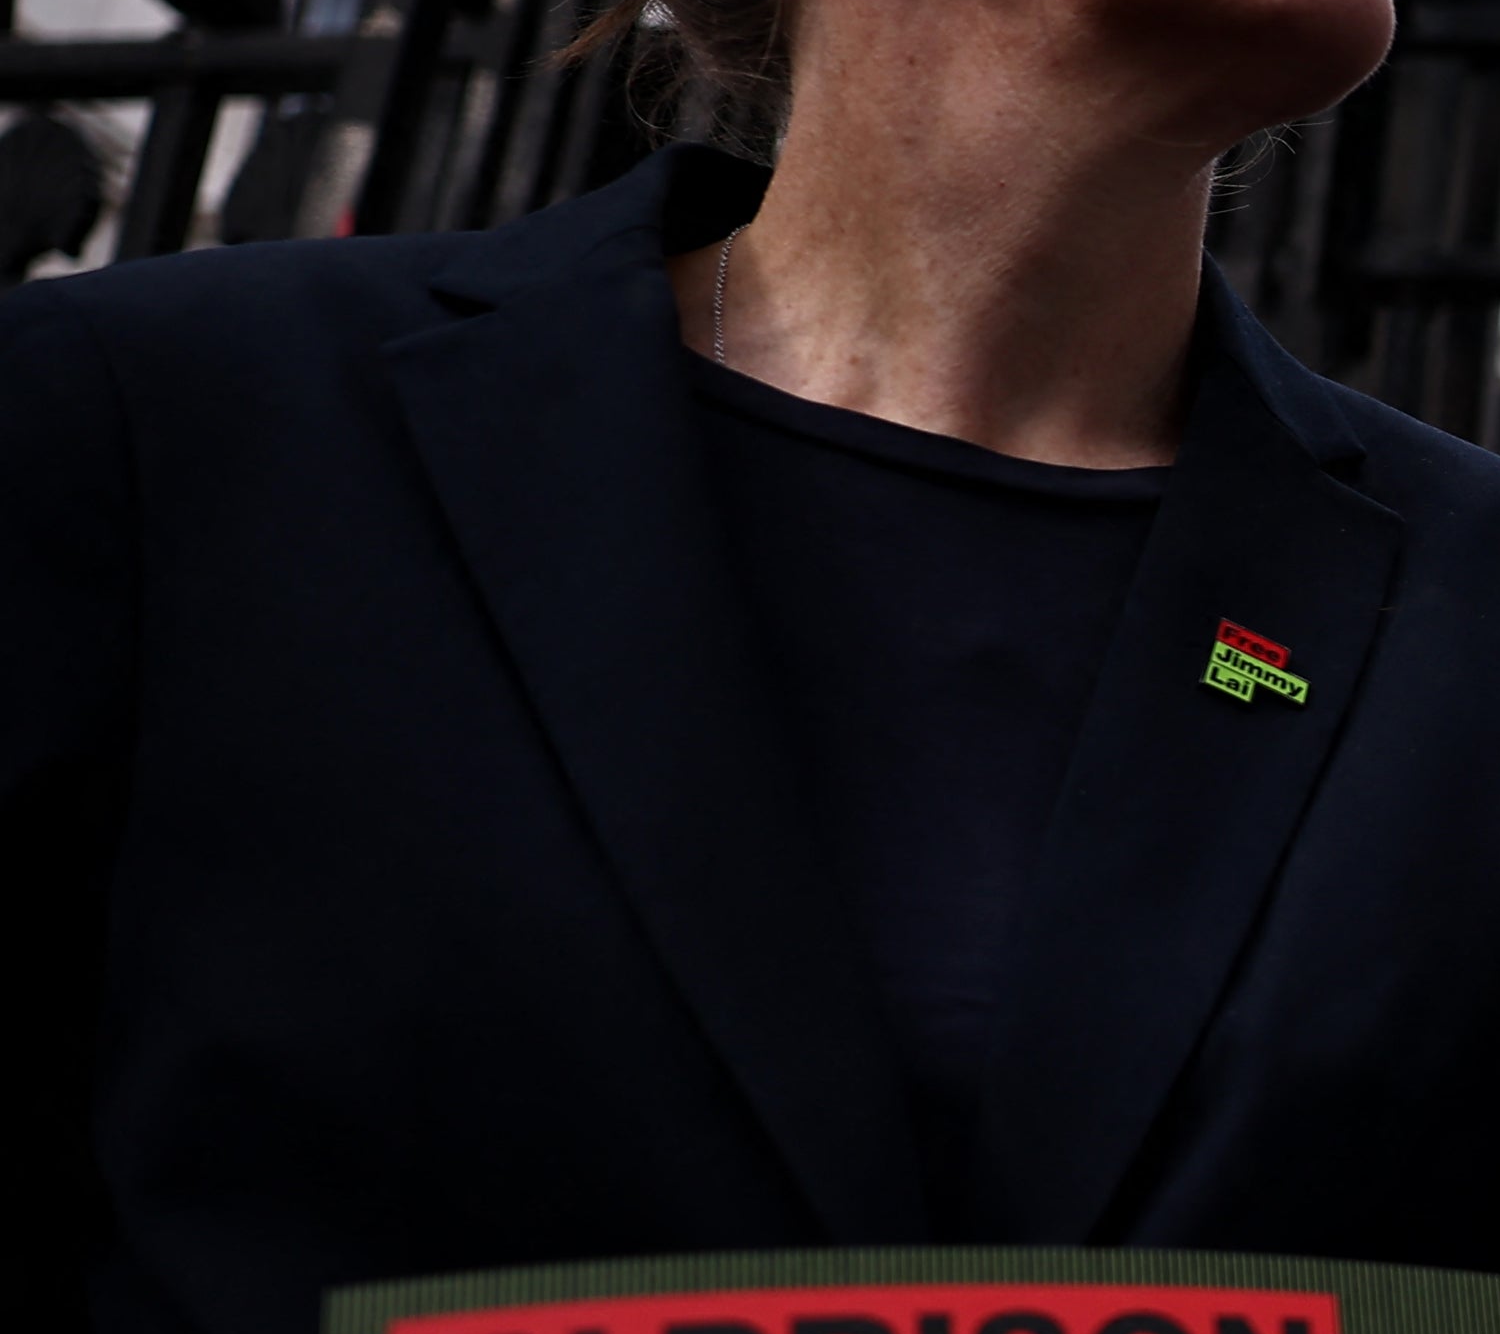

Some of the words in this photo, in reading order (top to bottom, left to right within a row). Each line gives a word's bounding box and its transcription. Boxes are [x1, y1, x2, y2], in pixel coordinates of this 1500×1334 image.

[1222, 627, 1280, 662] Free
[1210, 667, 1250, 695] Lai
[1216, 649, 1304, 697] Jimmy
